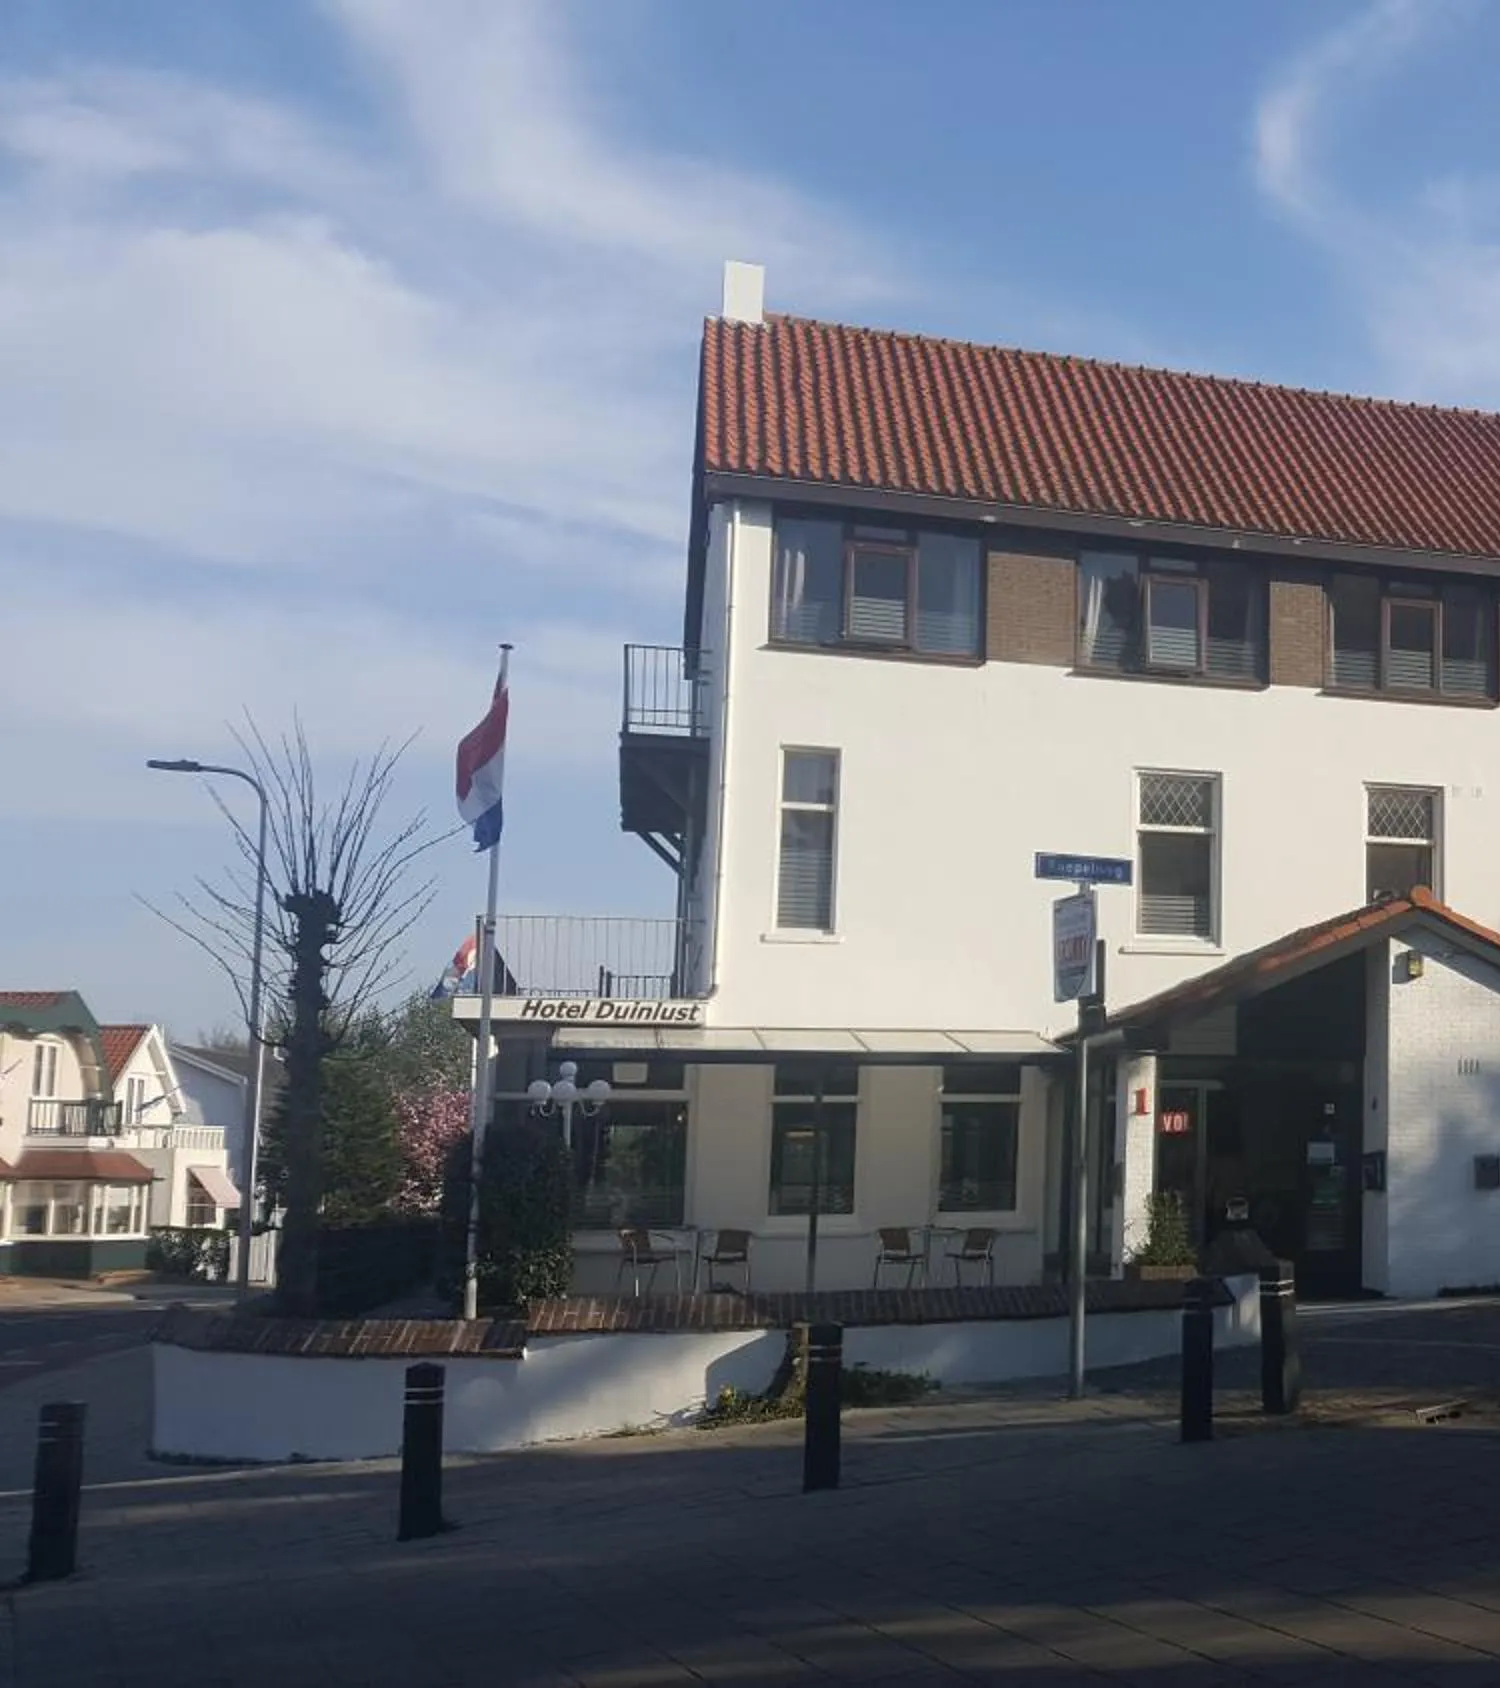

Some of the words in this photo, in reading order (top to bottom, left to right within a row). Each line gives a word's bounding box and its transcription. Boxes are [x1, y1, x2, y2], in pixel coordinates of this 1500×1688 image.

[522, 1000, 589, 1018] Hotel
[595, 1001, 699, 1020] Duinlust
[1132, 1088, 1150, 1115] 1
